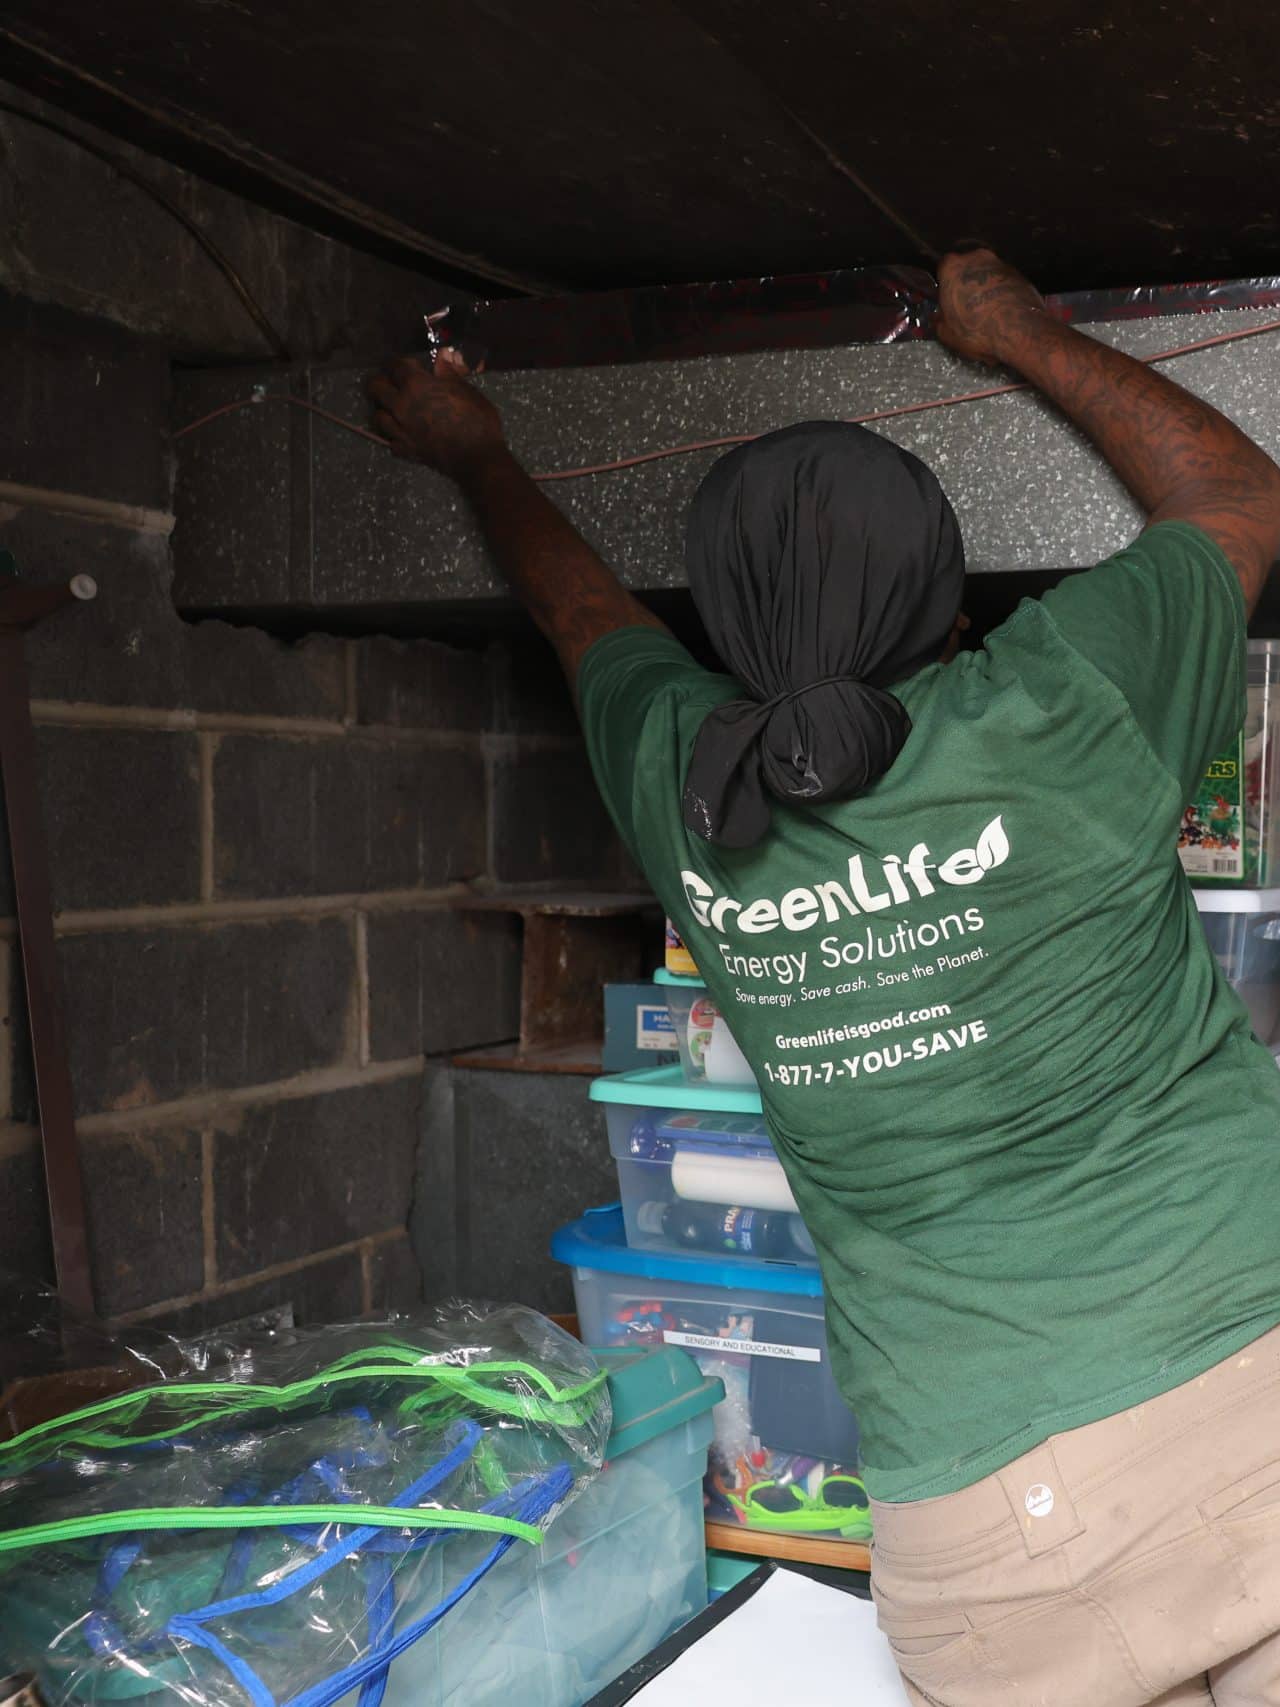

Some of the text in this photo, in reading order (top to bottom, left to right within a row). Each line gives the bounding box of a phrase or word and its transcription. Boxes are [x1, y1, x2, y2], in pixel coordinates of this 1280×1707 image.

[1207, 762, 1235, 777] RS
[681, 843, 987, 933] GreenLife
[719, 908, 984, 985] Energy Solutions
[736, 946, 989, 1007] Save energy. Save cash. Save the Planet.
[764, 1020, 988, 1085] 1-877-7-YOU-SAVE
[776, 1004, 951, 1049] Greenlifeisgood.com
[685, 1335, 795, 1356] SENSORY AND EDUCATIONAL
